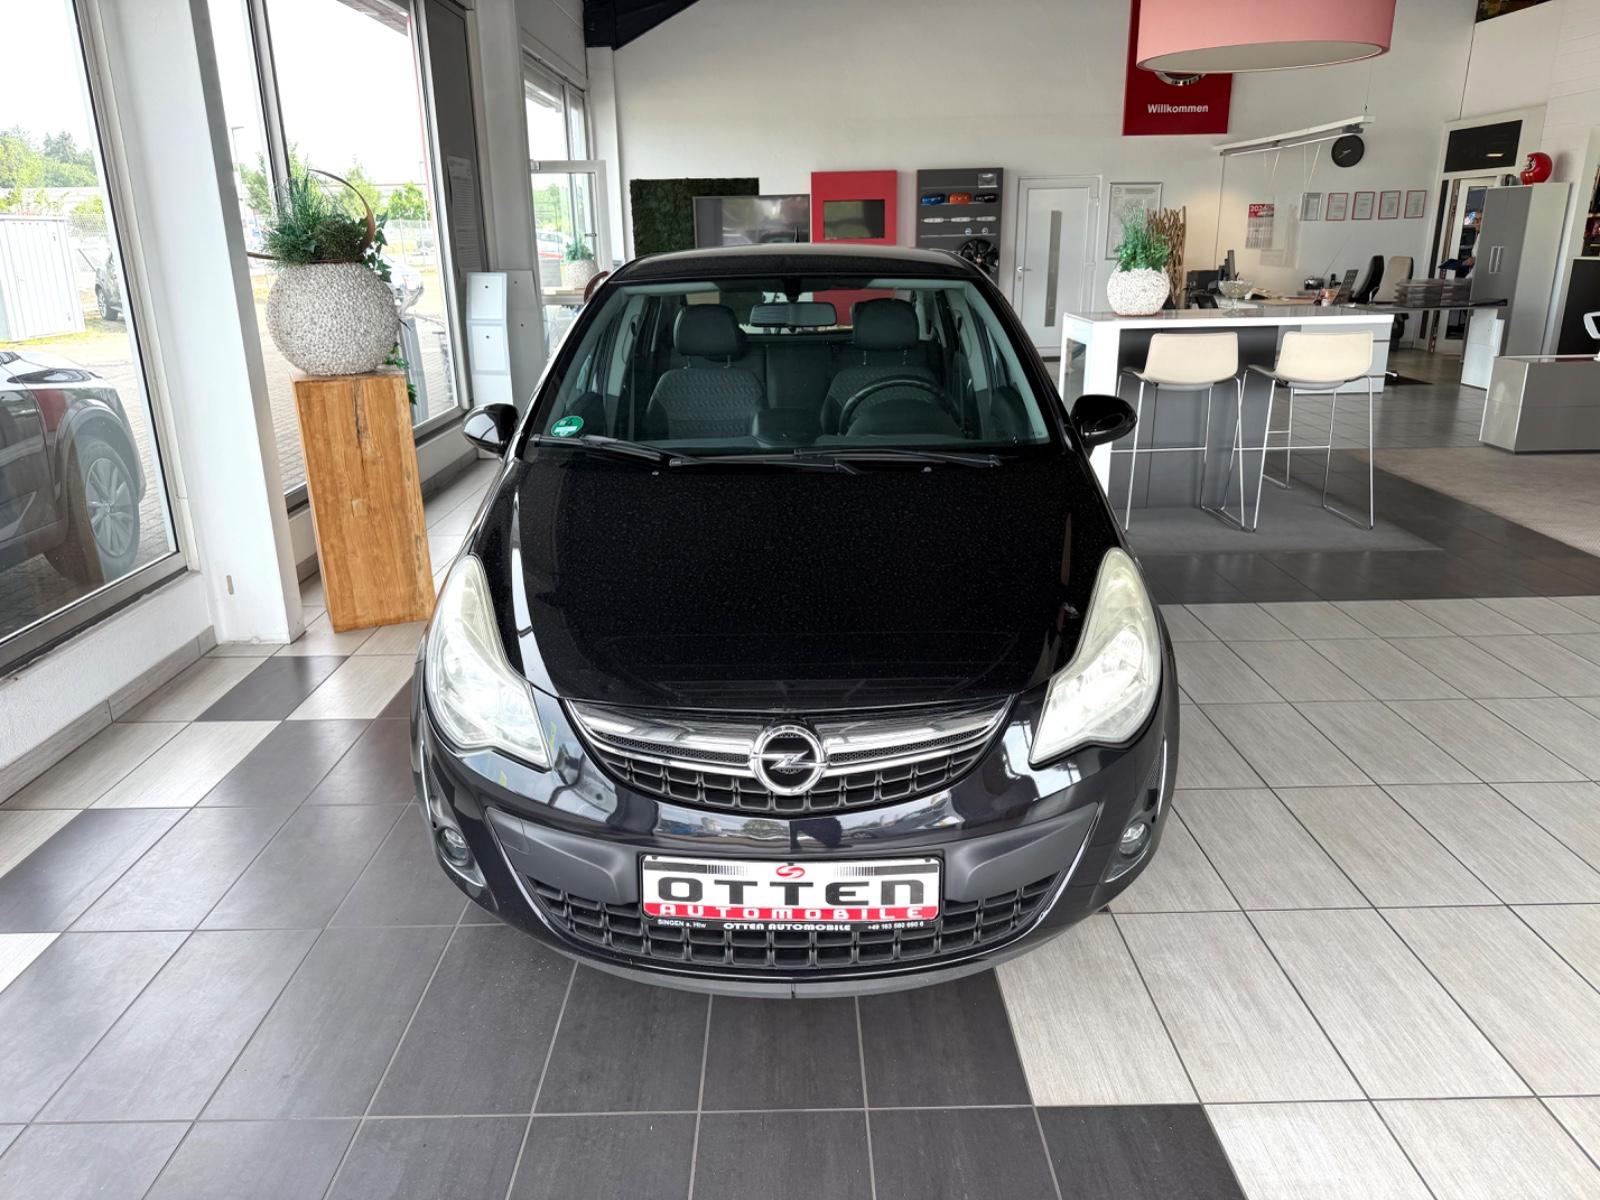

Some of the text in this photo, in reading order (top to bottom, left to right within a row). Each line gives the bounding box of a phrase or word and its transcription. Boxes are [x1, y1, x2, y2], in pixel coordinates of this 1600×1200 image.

[1147, 103, 1209, 114] Willkommen
[658, 876, 924, 906] OTTEN
[659, 903, 924, 920] AUTOMOBILE
[723, 922, 851, 931] OTTEN AUTOMOBILE
